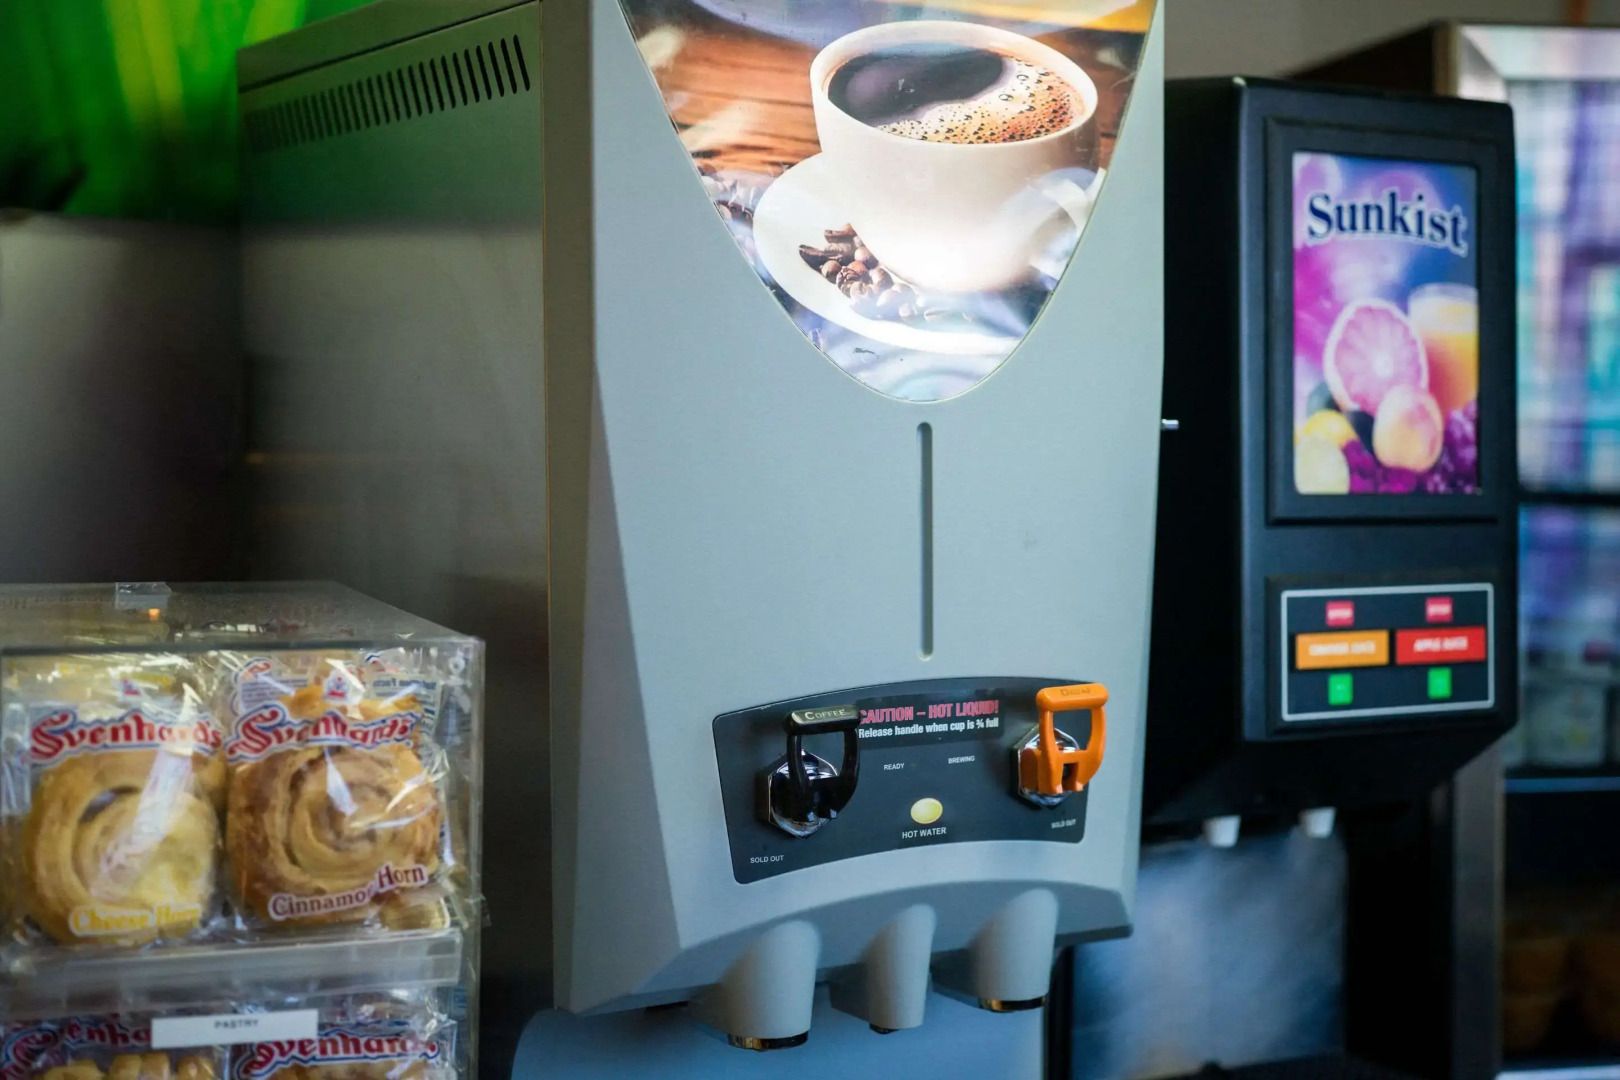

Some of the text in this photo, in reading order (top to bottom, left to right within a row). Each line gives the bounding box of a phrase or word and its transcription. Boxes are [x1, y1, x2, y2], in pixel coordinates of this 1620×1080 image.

[1307, 189, 1468, 254] Sunkist
[804, 708, 845, 721] COFFEE
[859, 706, 914, 725] CAUTION
[928, 703, 954, 719] HOT
[955, 700, 999, 717] LIQUID!
[858, 726, 893, 739] Release
[894, 722, 924, 736] handle
[925, 721, 949, 734] when
[949, 720, 966, 733] cup
[966, 719, 975, 730] is
[985, 717, 999, 729] full
[947, 755, 976, 764] BREWING
[883, 762, 905, 771] READY
[901, 826, 947, 839] HOT WATER
[750, 854, 785, 864] SOLD OUT
[377, 864, 425, 889] Horn
[213, 1019, 260, 1030] PASTRY
